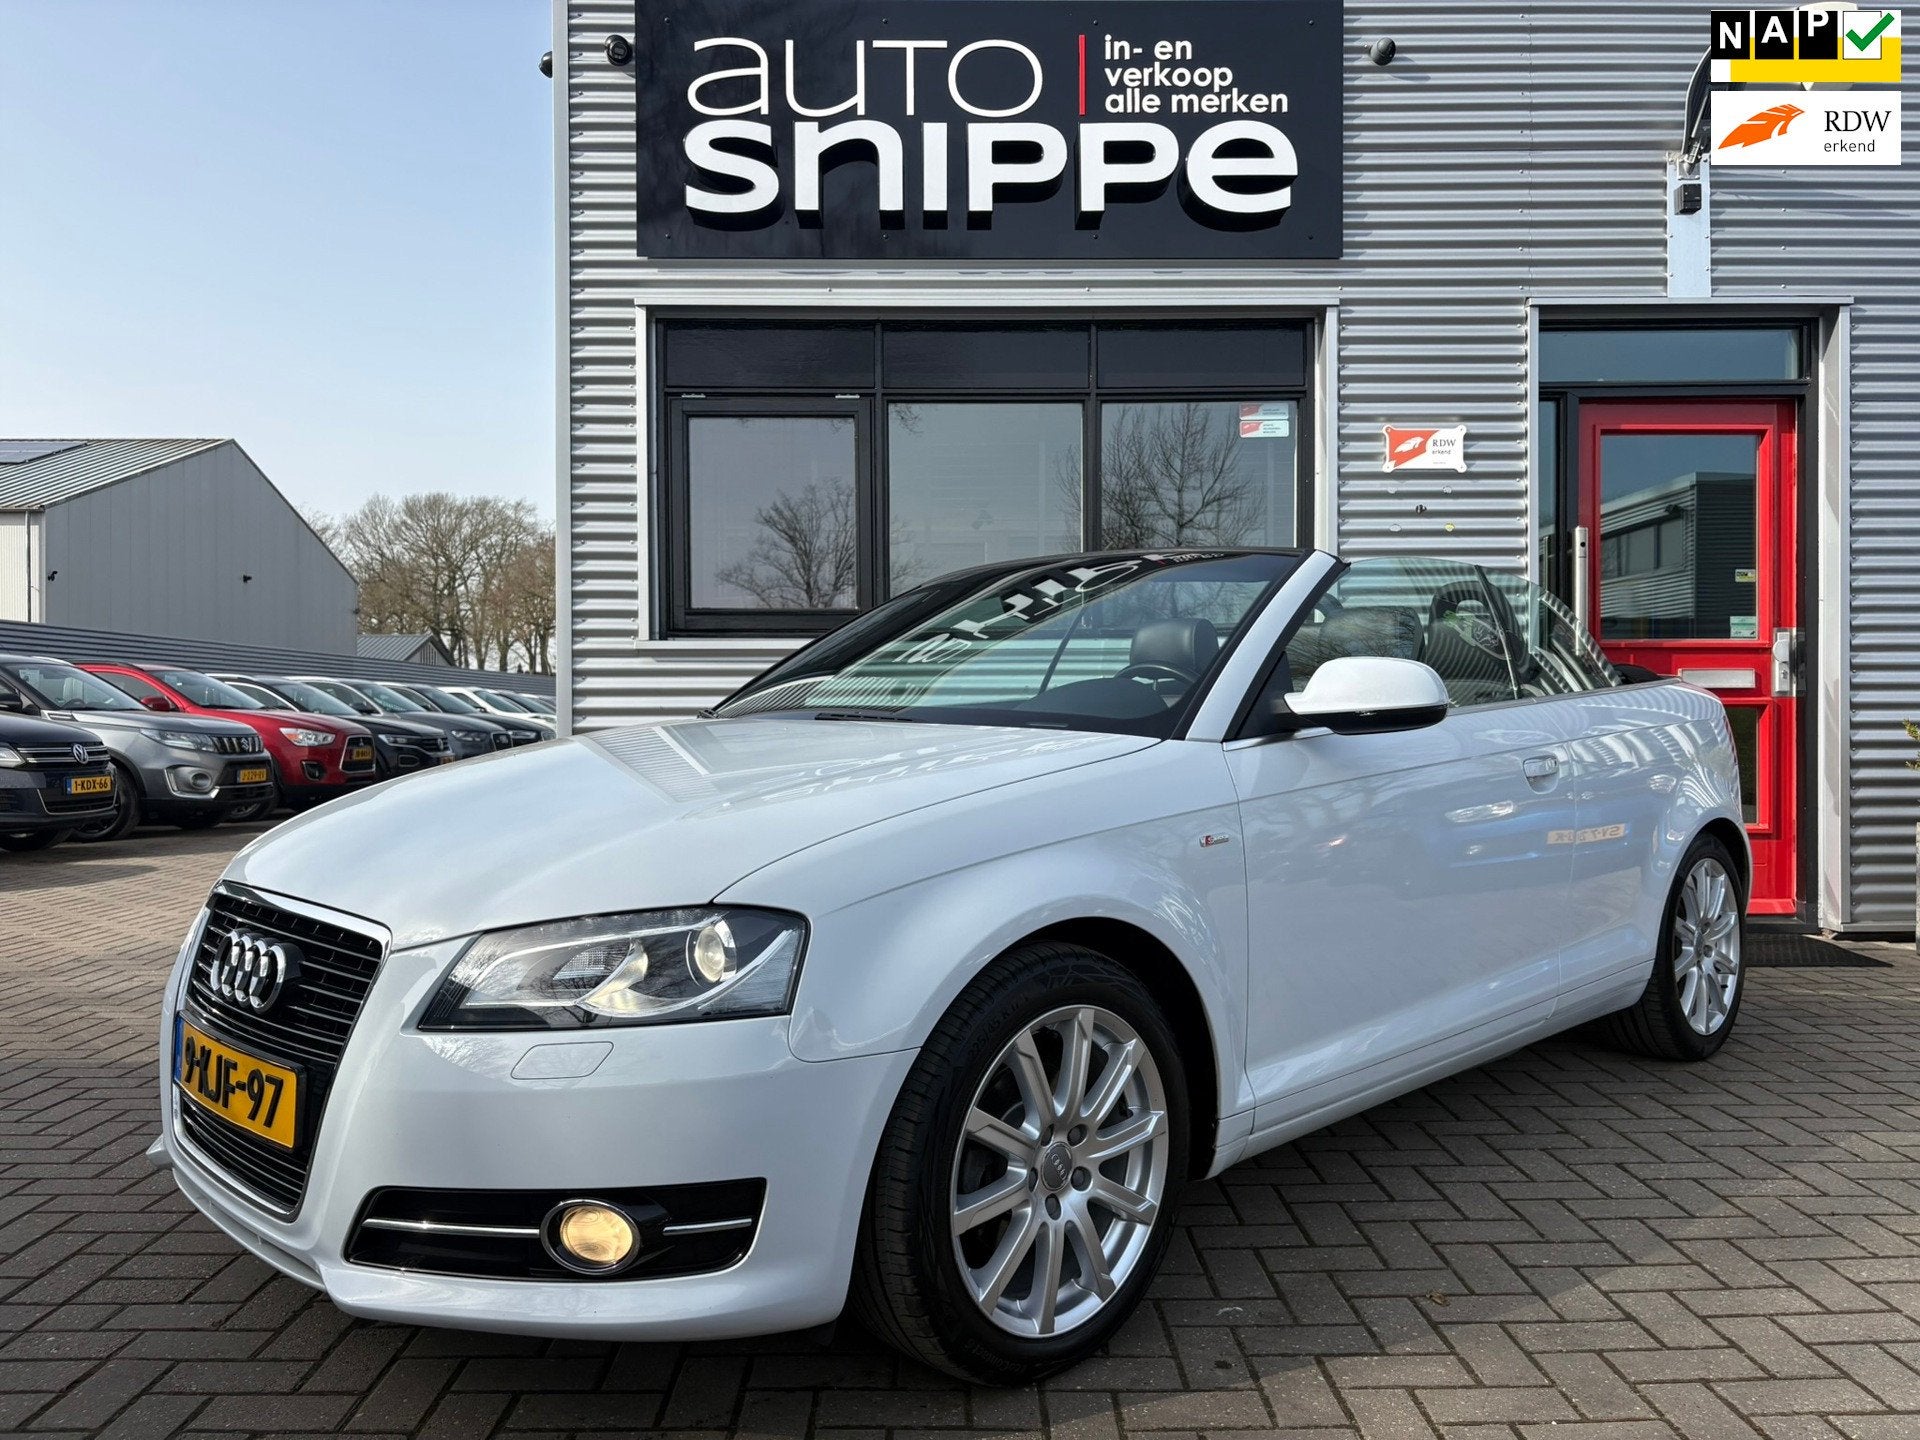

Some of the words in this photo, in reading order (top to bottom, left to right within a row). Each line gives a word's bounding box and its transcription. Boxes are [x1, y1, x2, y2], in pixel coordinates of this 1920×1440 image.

[1104, 35, 1143, 61] in-
[1153, 40, 1193, 61] en
[1104, 62, 1234, 92] verkoop
[1104, 91, 1163, 114] alle
[1170, 89, 1289, 114] merken
[1431, 438, 1457, 447] RDW
[74, 778, 109, 791] 1-KDX-66
[184, 1036, 284, 1128] 9-KJF-97
